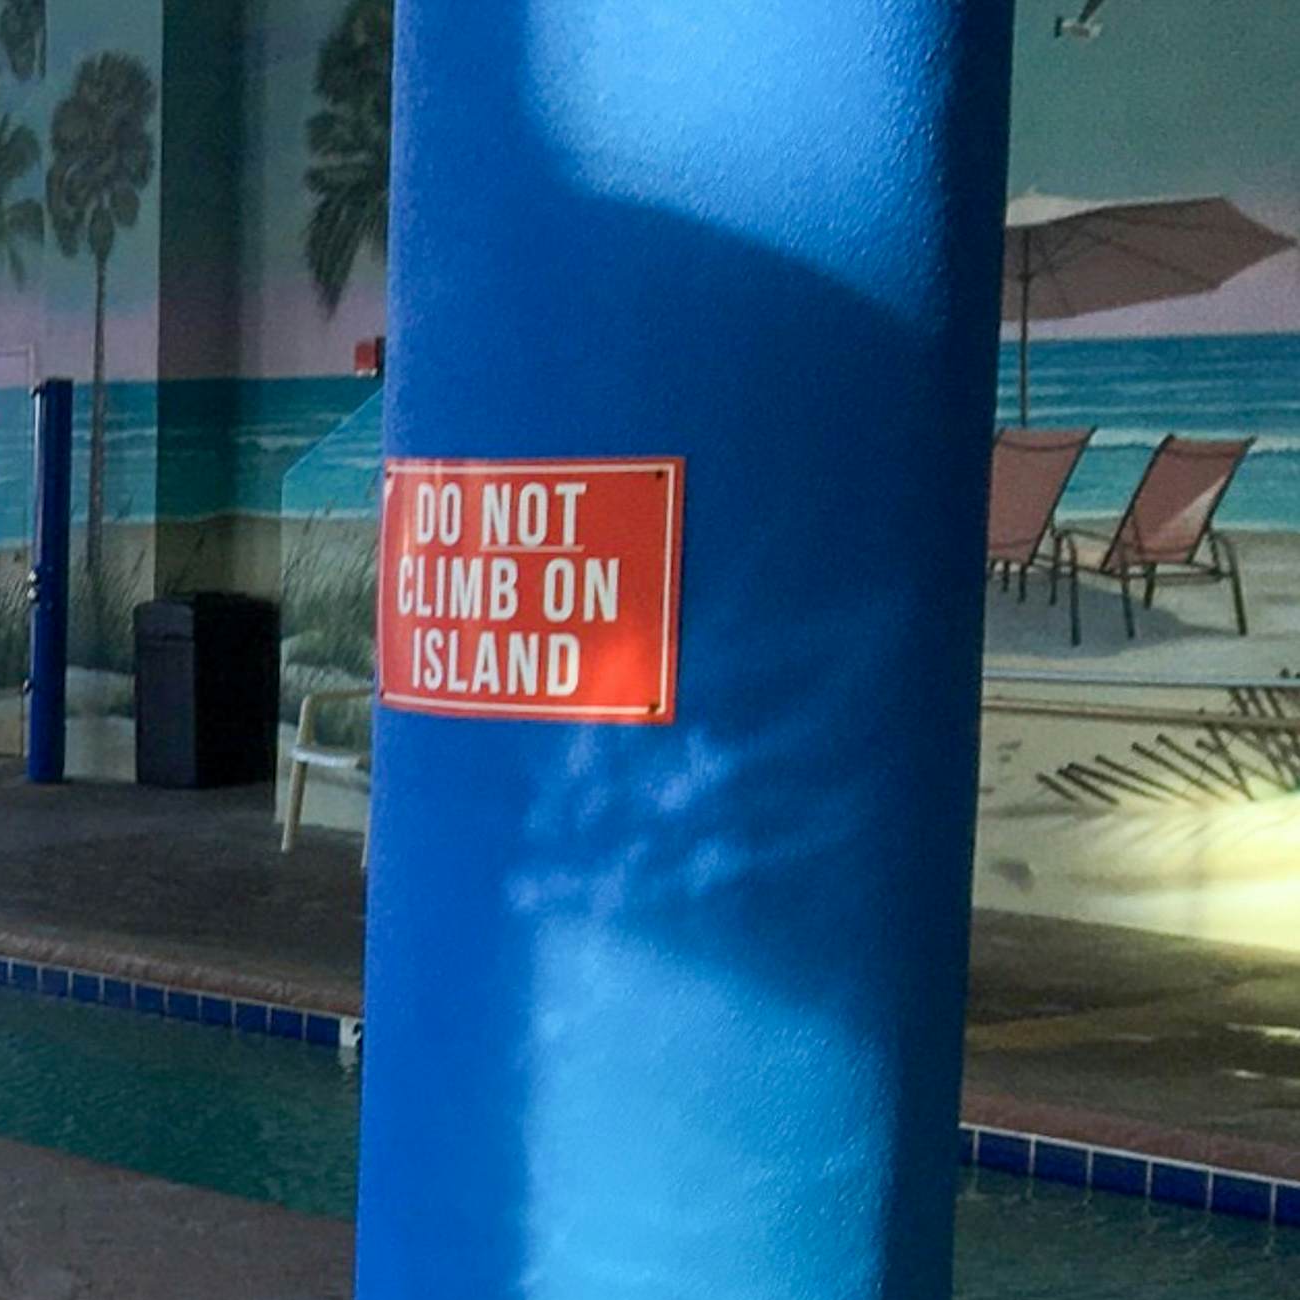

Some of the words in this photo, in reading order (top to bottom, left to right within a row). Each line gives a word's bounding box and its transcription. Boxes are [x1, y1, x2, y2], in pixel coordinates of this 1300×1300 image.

[416, 482, 462, 546] DO
[480, 483, 588, 549] NOT
[398, 556, 519, 621] CLIMB
[544, 559, 620, 623] ON
[412, 628, 580, 696] ISLAND
